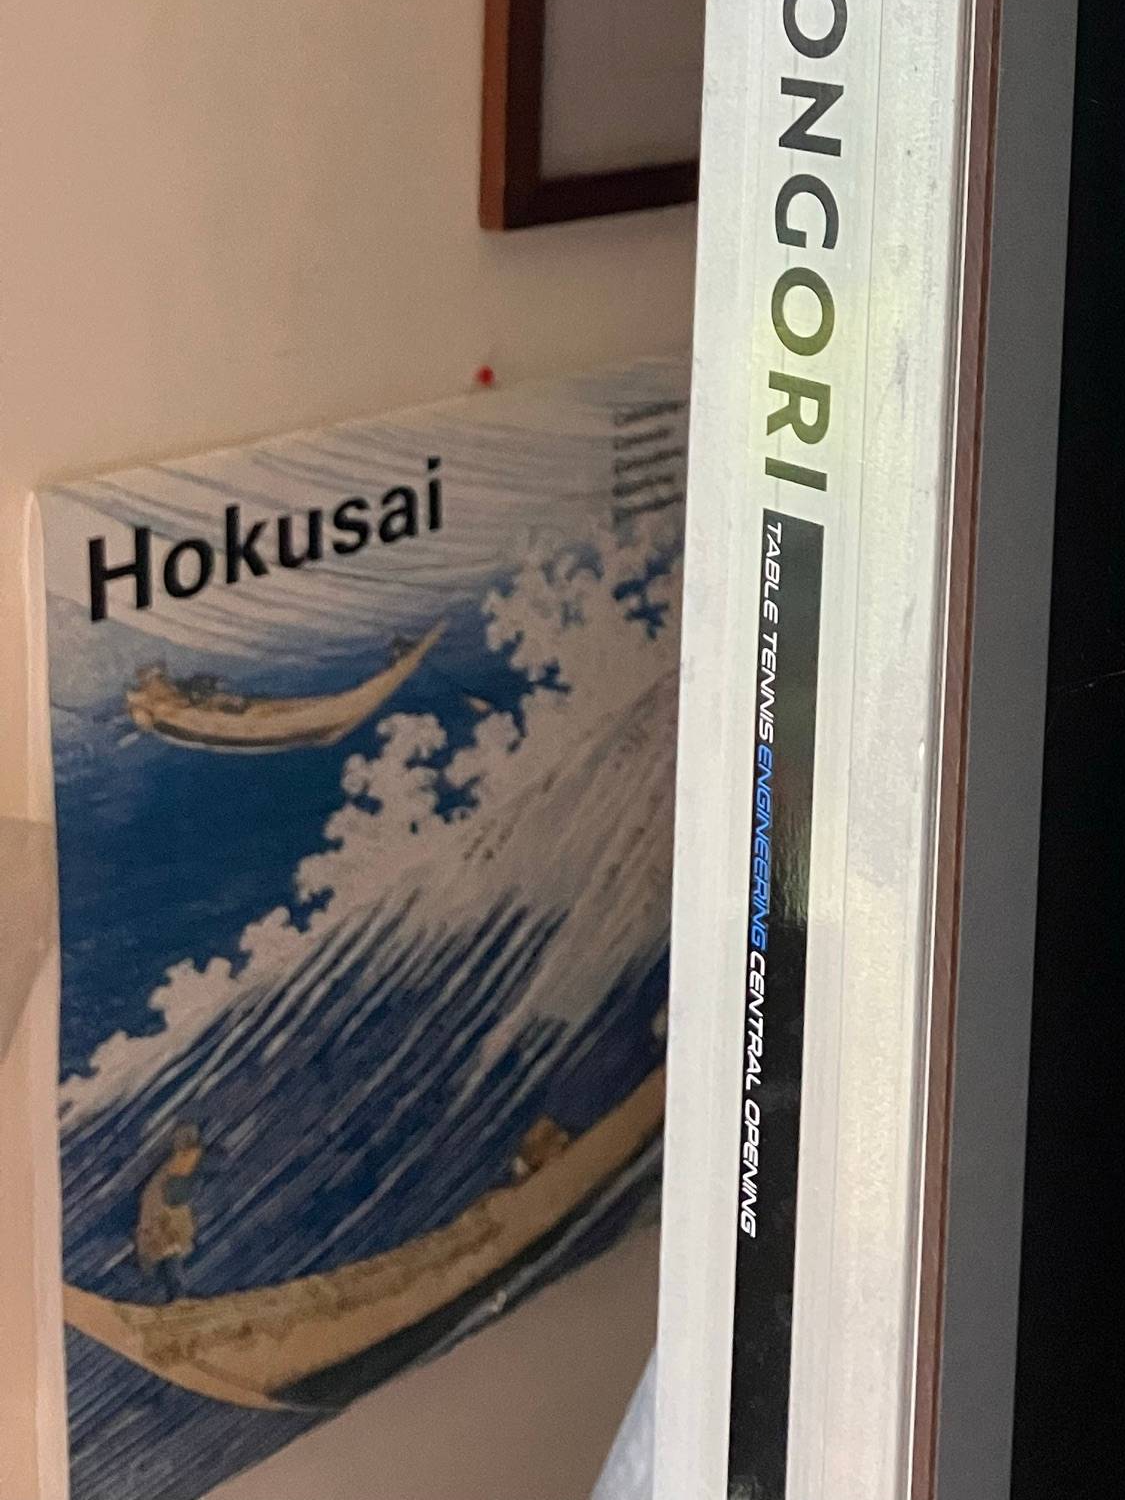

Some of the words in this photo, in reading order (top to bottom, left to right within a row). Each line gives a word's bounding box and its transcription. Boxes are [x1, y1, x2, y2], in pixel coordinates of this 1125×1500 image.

[87, 457, 444, 623] Hokusai
[762, 522, 782, 624] TABLE
[758, 631, 778, 743] TENNIS
[751, 743, 773, 950] ENGINEERING
[746, 950, 766, 1090] CENTRAL
[740, 1098, 761, 1238] OPENING
